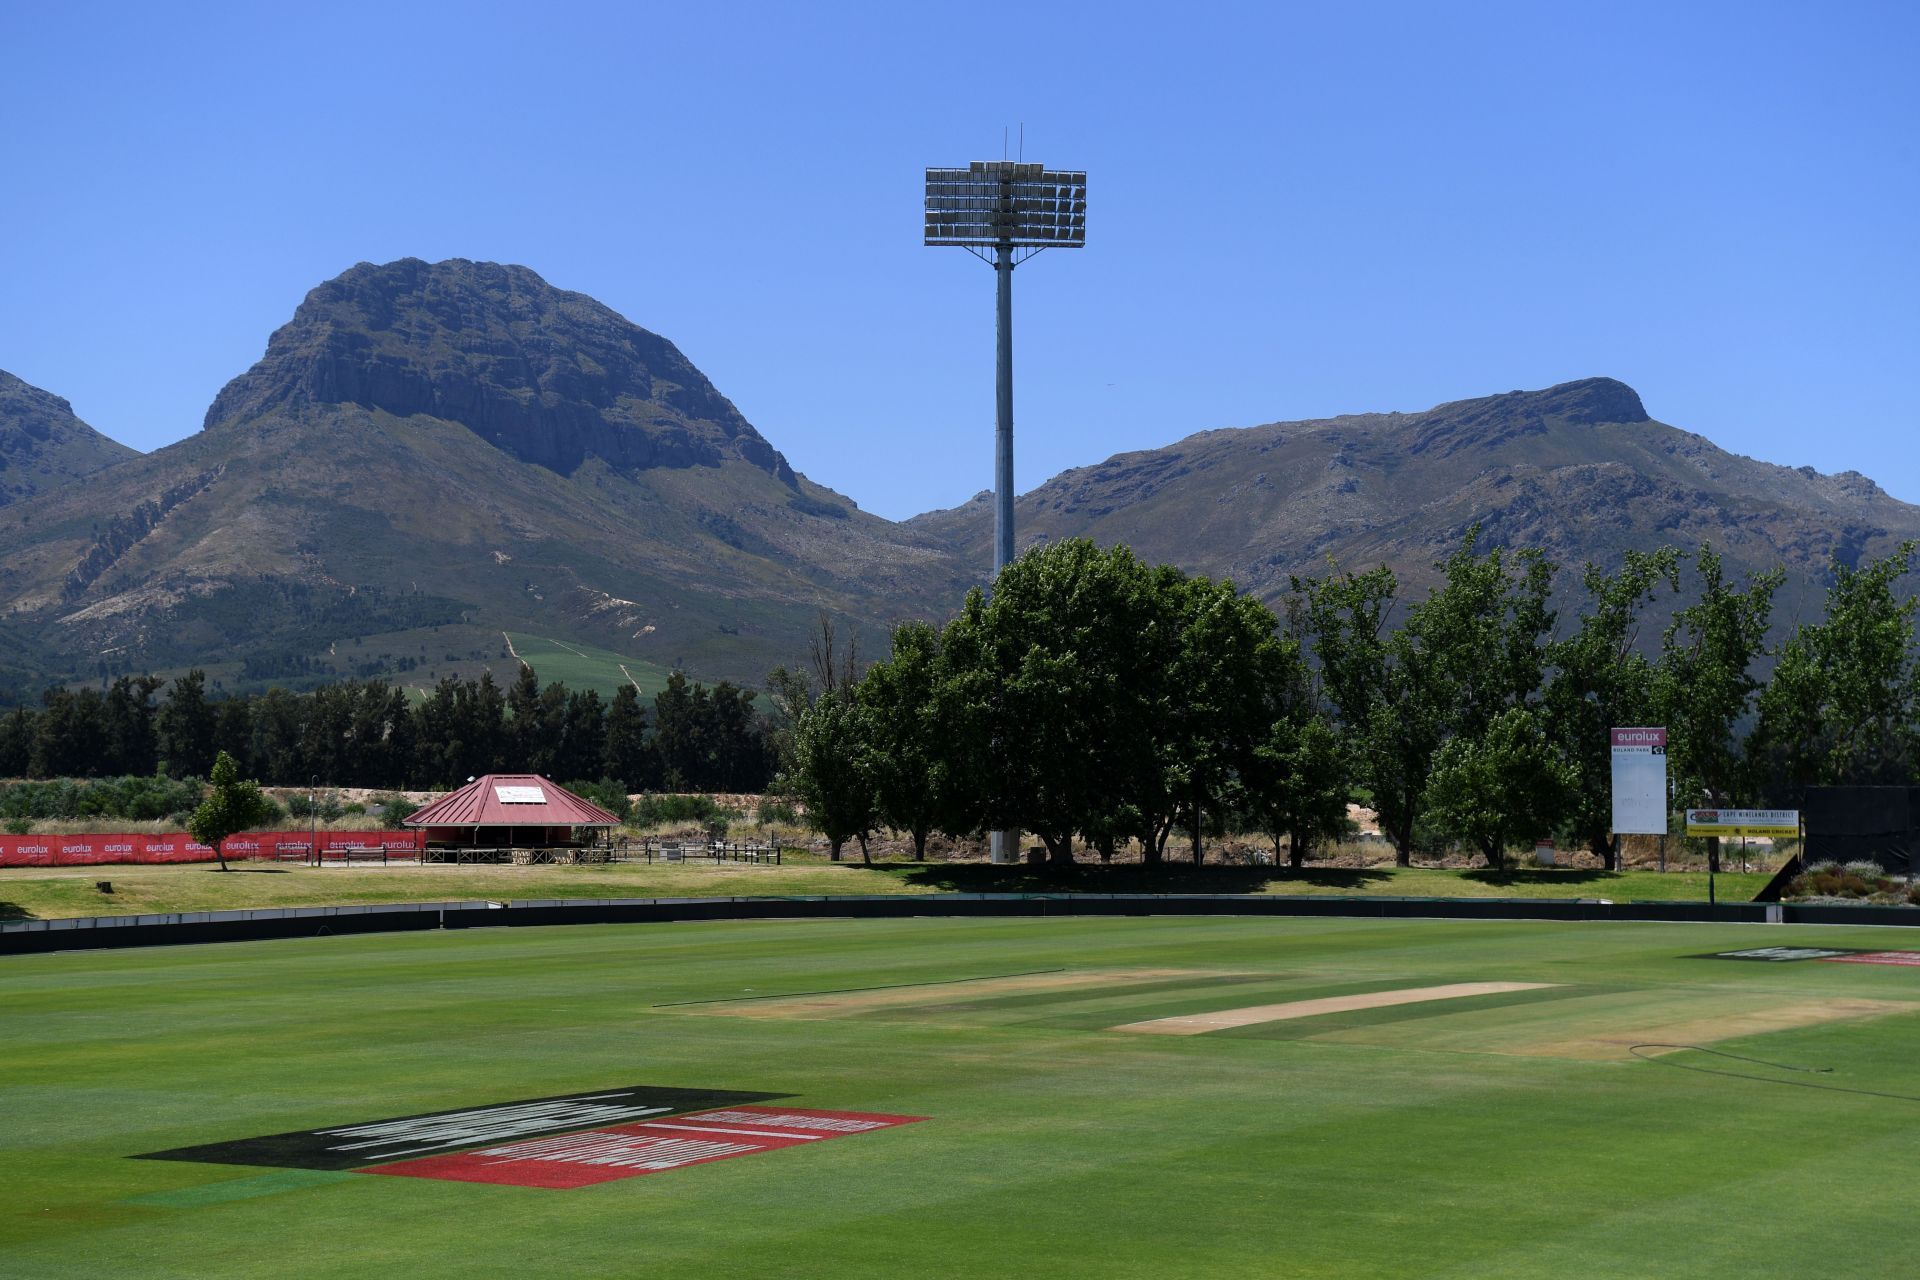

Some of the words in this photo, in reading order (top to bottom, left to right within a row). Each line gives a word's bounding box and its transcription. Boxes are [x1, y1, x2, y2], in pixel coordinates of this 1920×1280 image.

[1617, 731, 1660, 741] eurolux
[17, 845, 48, 854] eurolux
[62, 844, 92, 853] eurolux
[104, 844, 133, 852] eurolux
[146, 843, 174, 852] eurolux
[226, 841, 259, 850] eurolux
[329, 841, 365, 849] eurolux
[311, 1093, 675, 1160] betway
[467, 1131, 766, 1170] momentum
